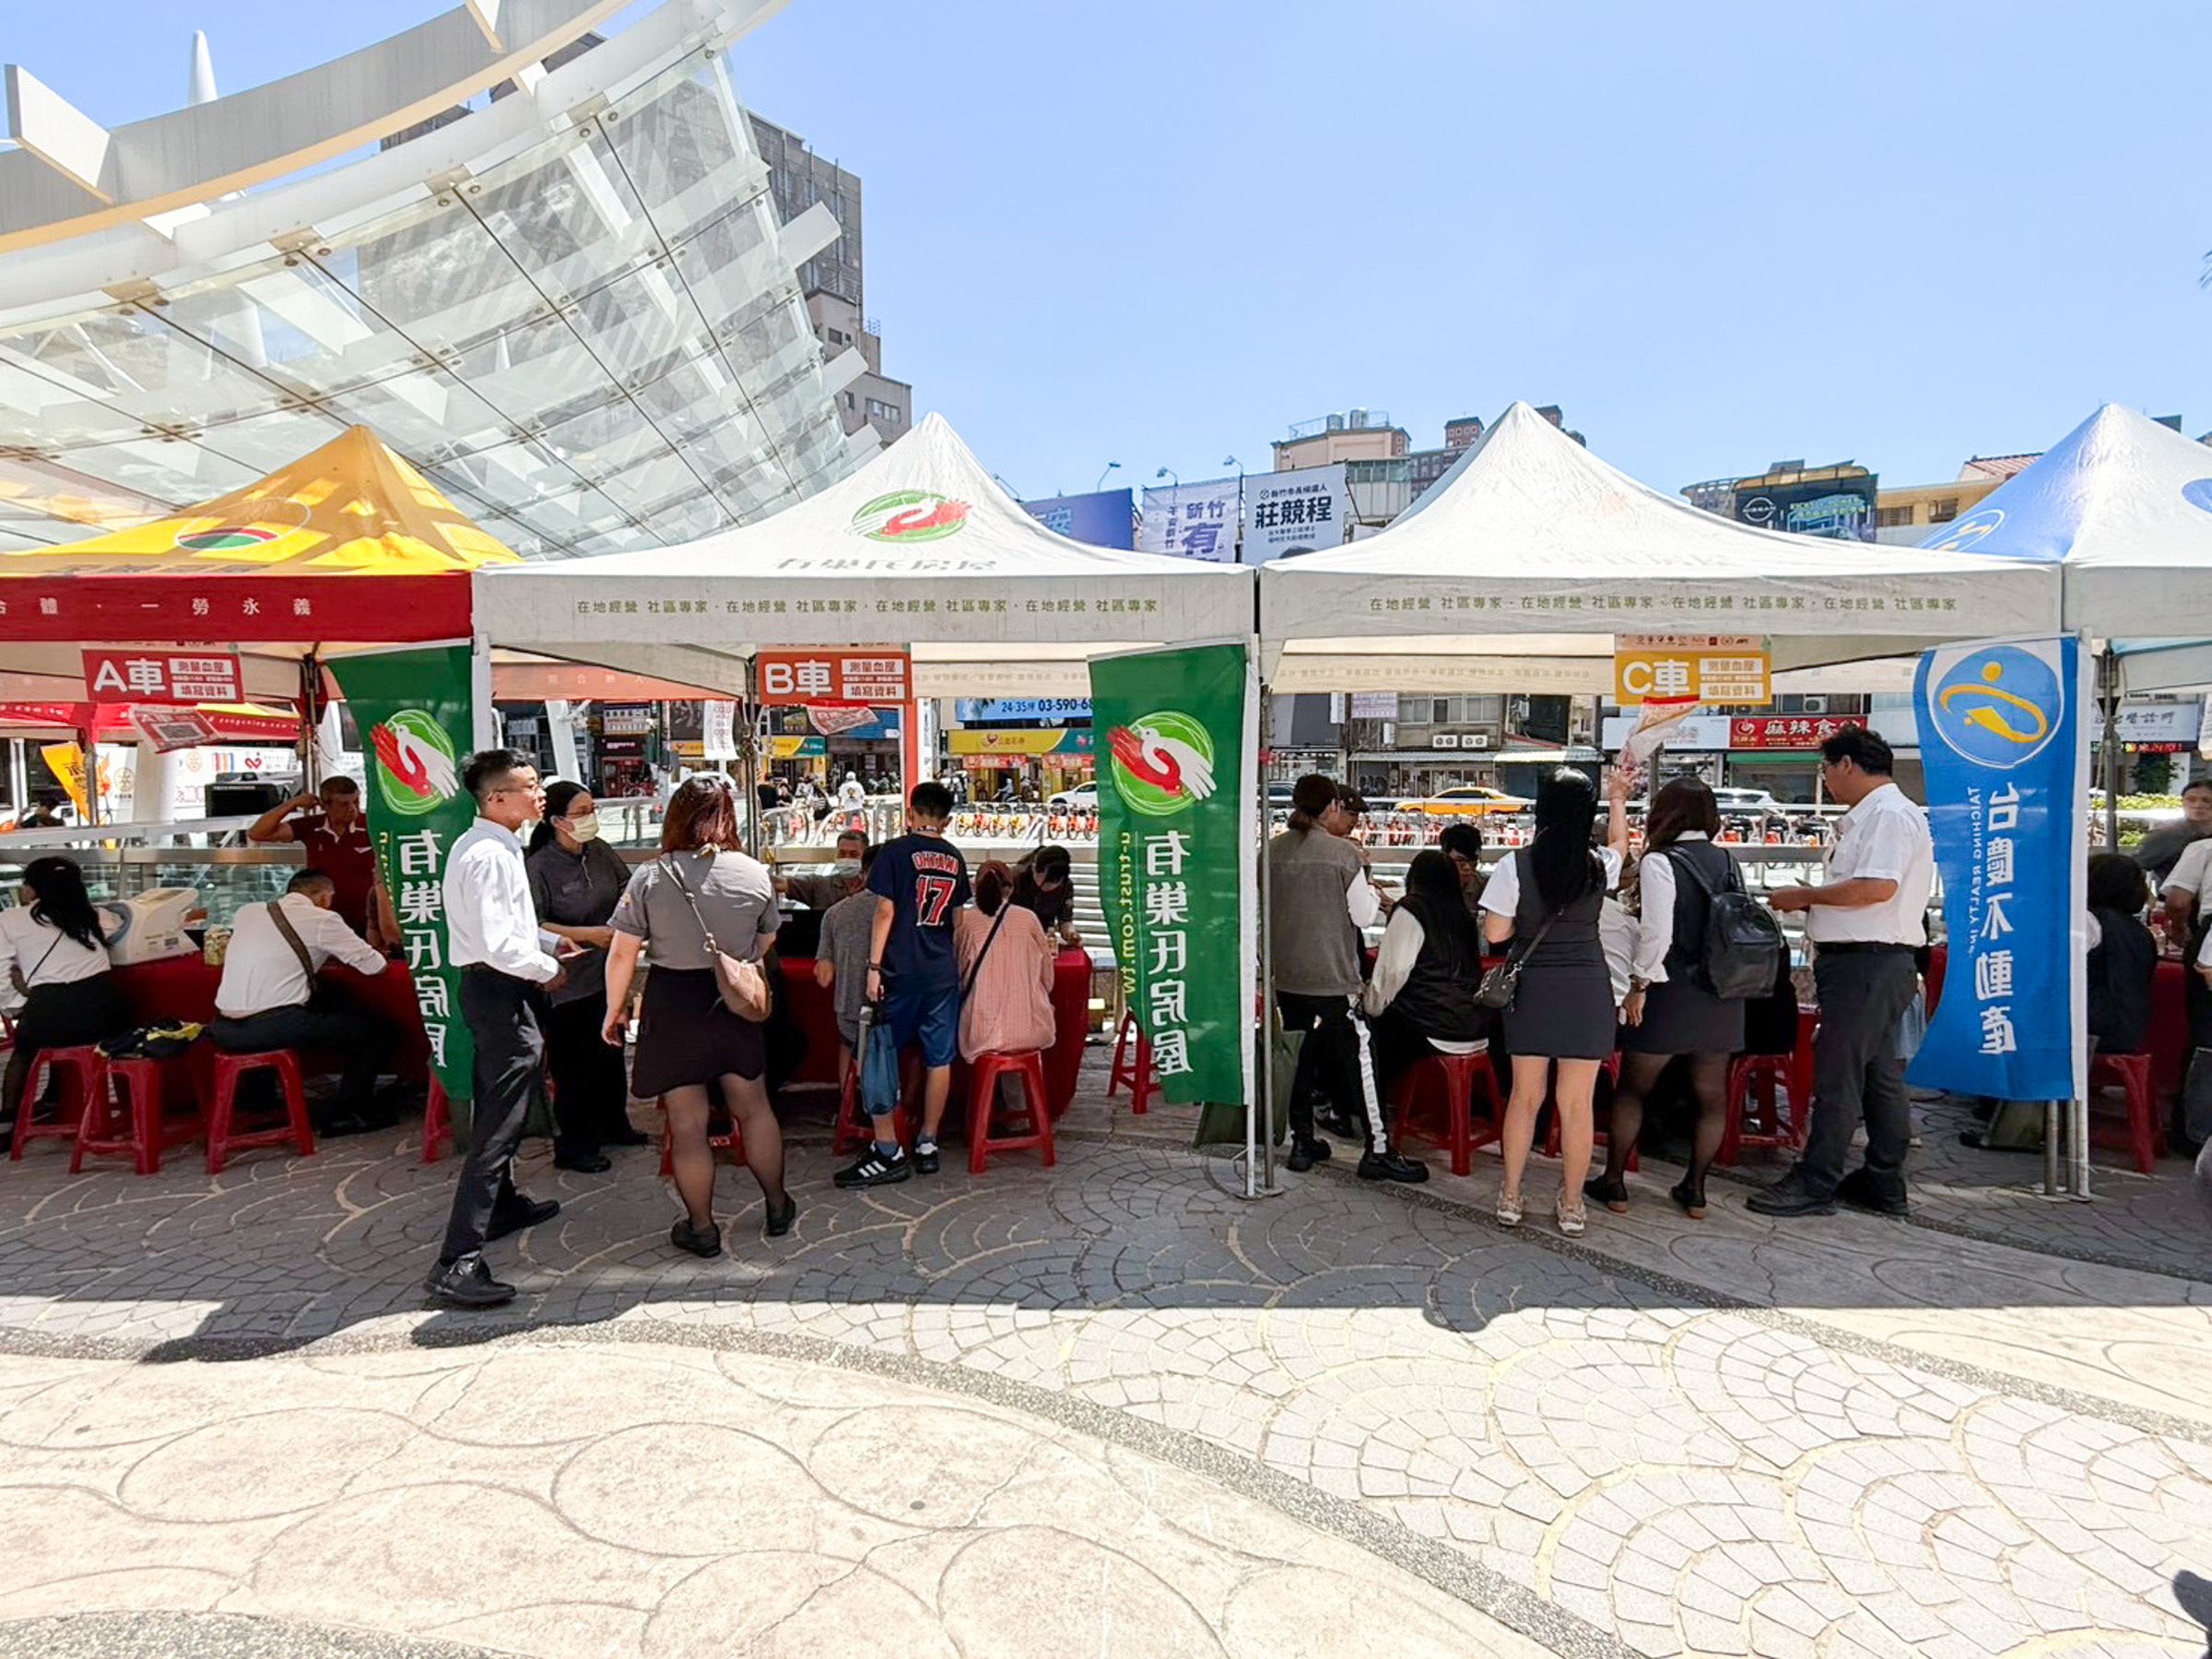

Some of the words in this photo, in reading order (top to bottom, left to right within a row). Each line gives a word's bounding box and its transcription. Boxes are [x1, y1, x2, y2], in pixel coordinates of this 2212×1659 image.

[1186, 500, 1225, 519] 新竹
[1255, 495, 1332, 529] 莊競程
[1181, 523, 1224, 555] 有
[93, 658, 167, 695] A車
[765, 659, 832, 697] B車
[852, 685, 897, 697] 填寫資料
[1623, 658, 1690, 697] C車
[916, 875, 957, 926] 17
